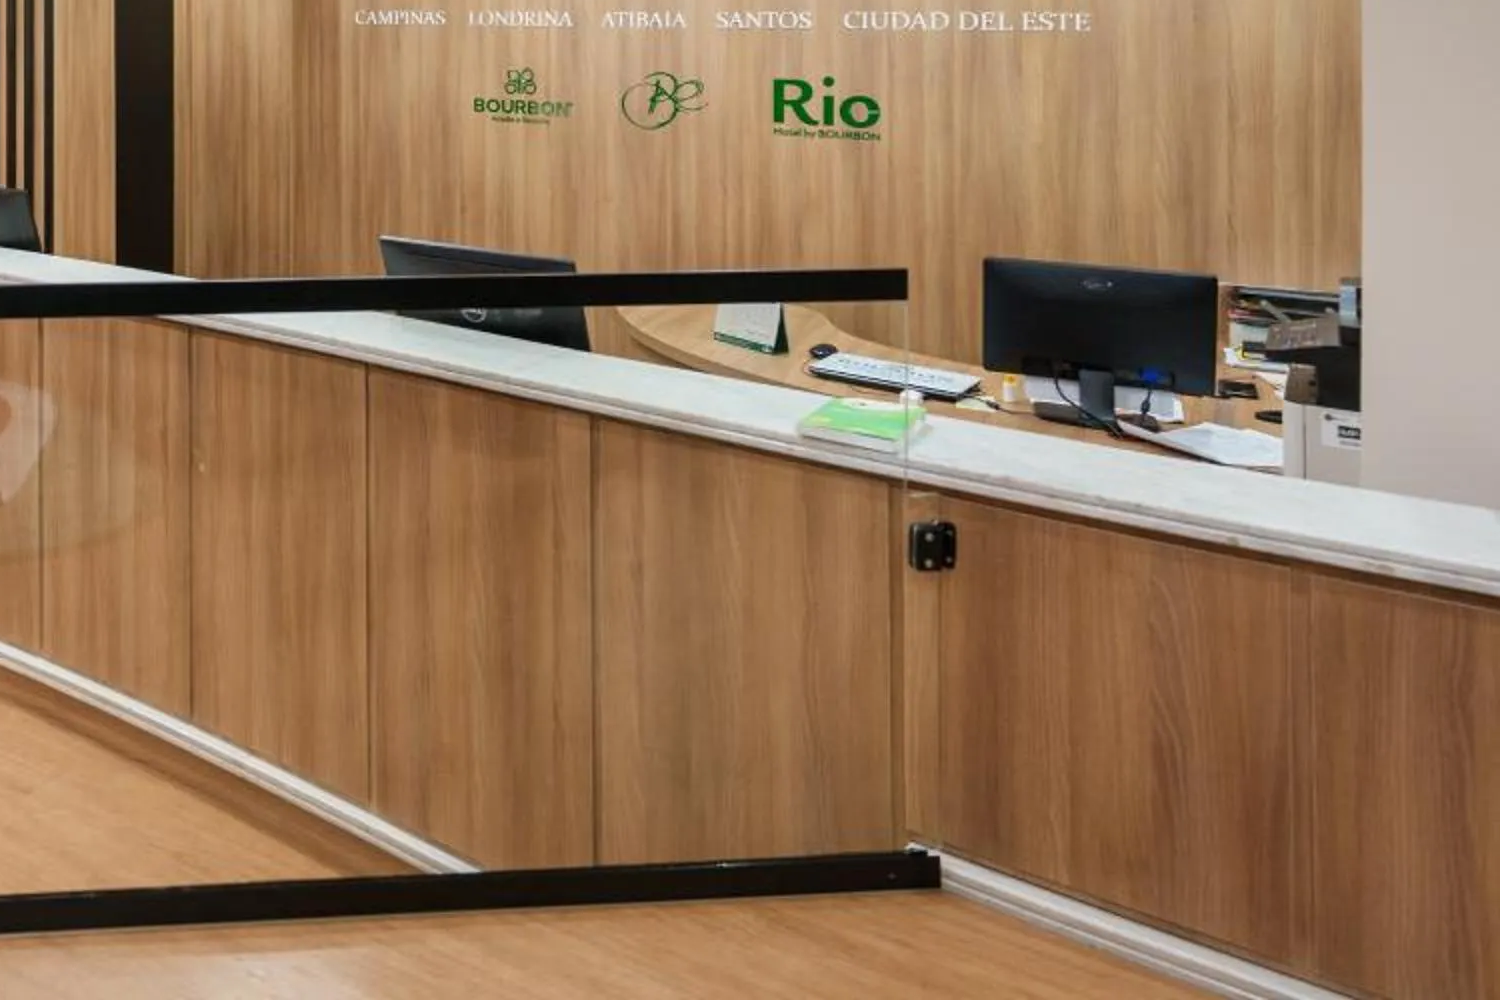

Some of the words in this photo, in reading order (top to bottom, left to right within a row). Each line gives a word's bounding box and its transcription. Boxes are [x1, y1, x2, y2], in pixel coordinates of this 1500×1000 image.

[355, 8, 446, 25] CAMPINAS
[468, 9, 574, 27] LONDRINA
[602, 10, 687, 29] ATIBAIA
[715, 10, 813, 30] SANTOS
[843, 10, 950, 31] CIUDAD
[958, 10, 1013, 31] DEL
[1022, 11, 1092, 32] ESTE
[473, 98, 570, 117] BOURBON
[772, 76, 881, 128] Rio
